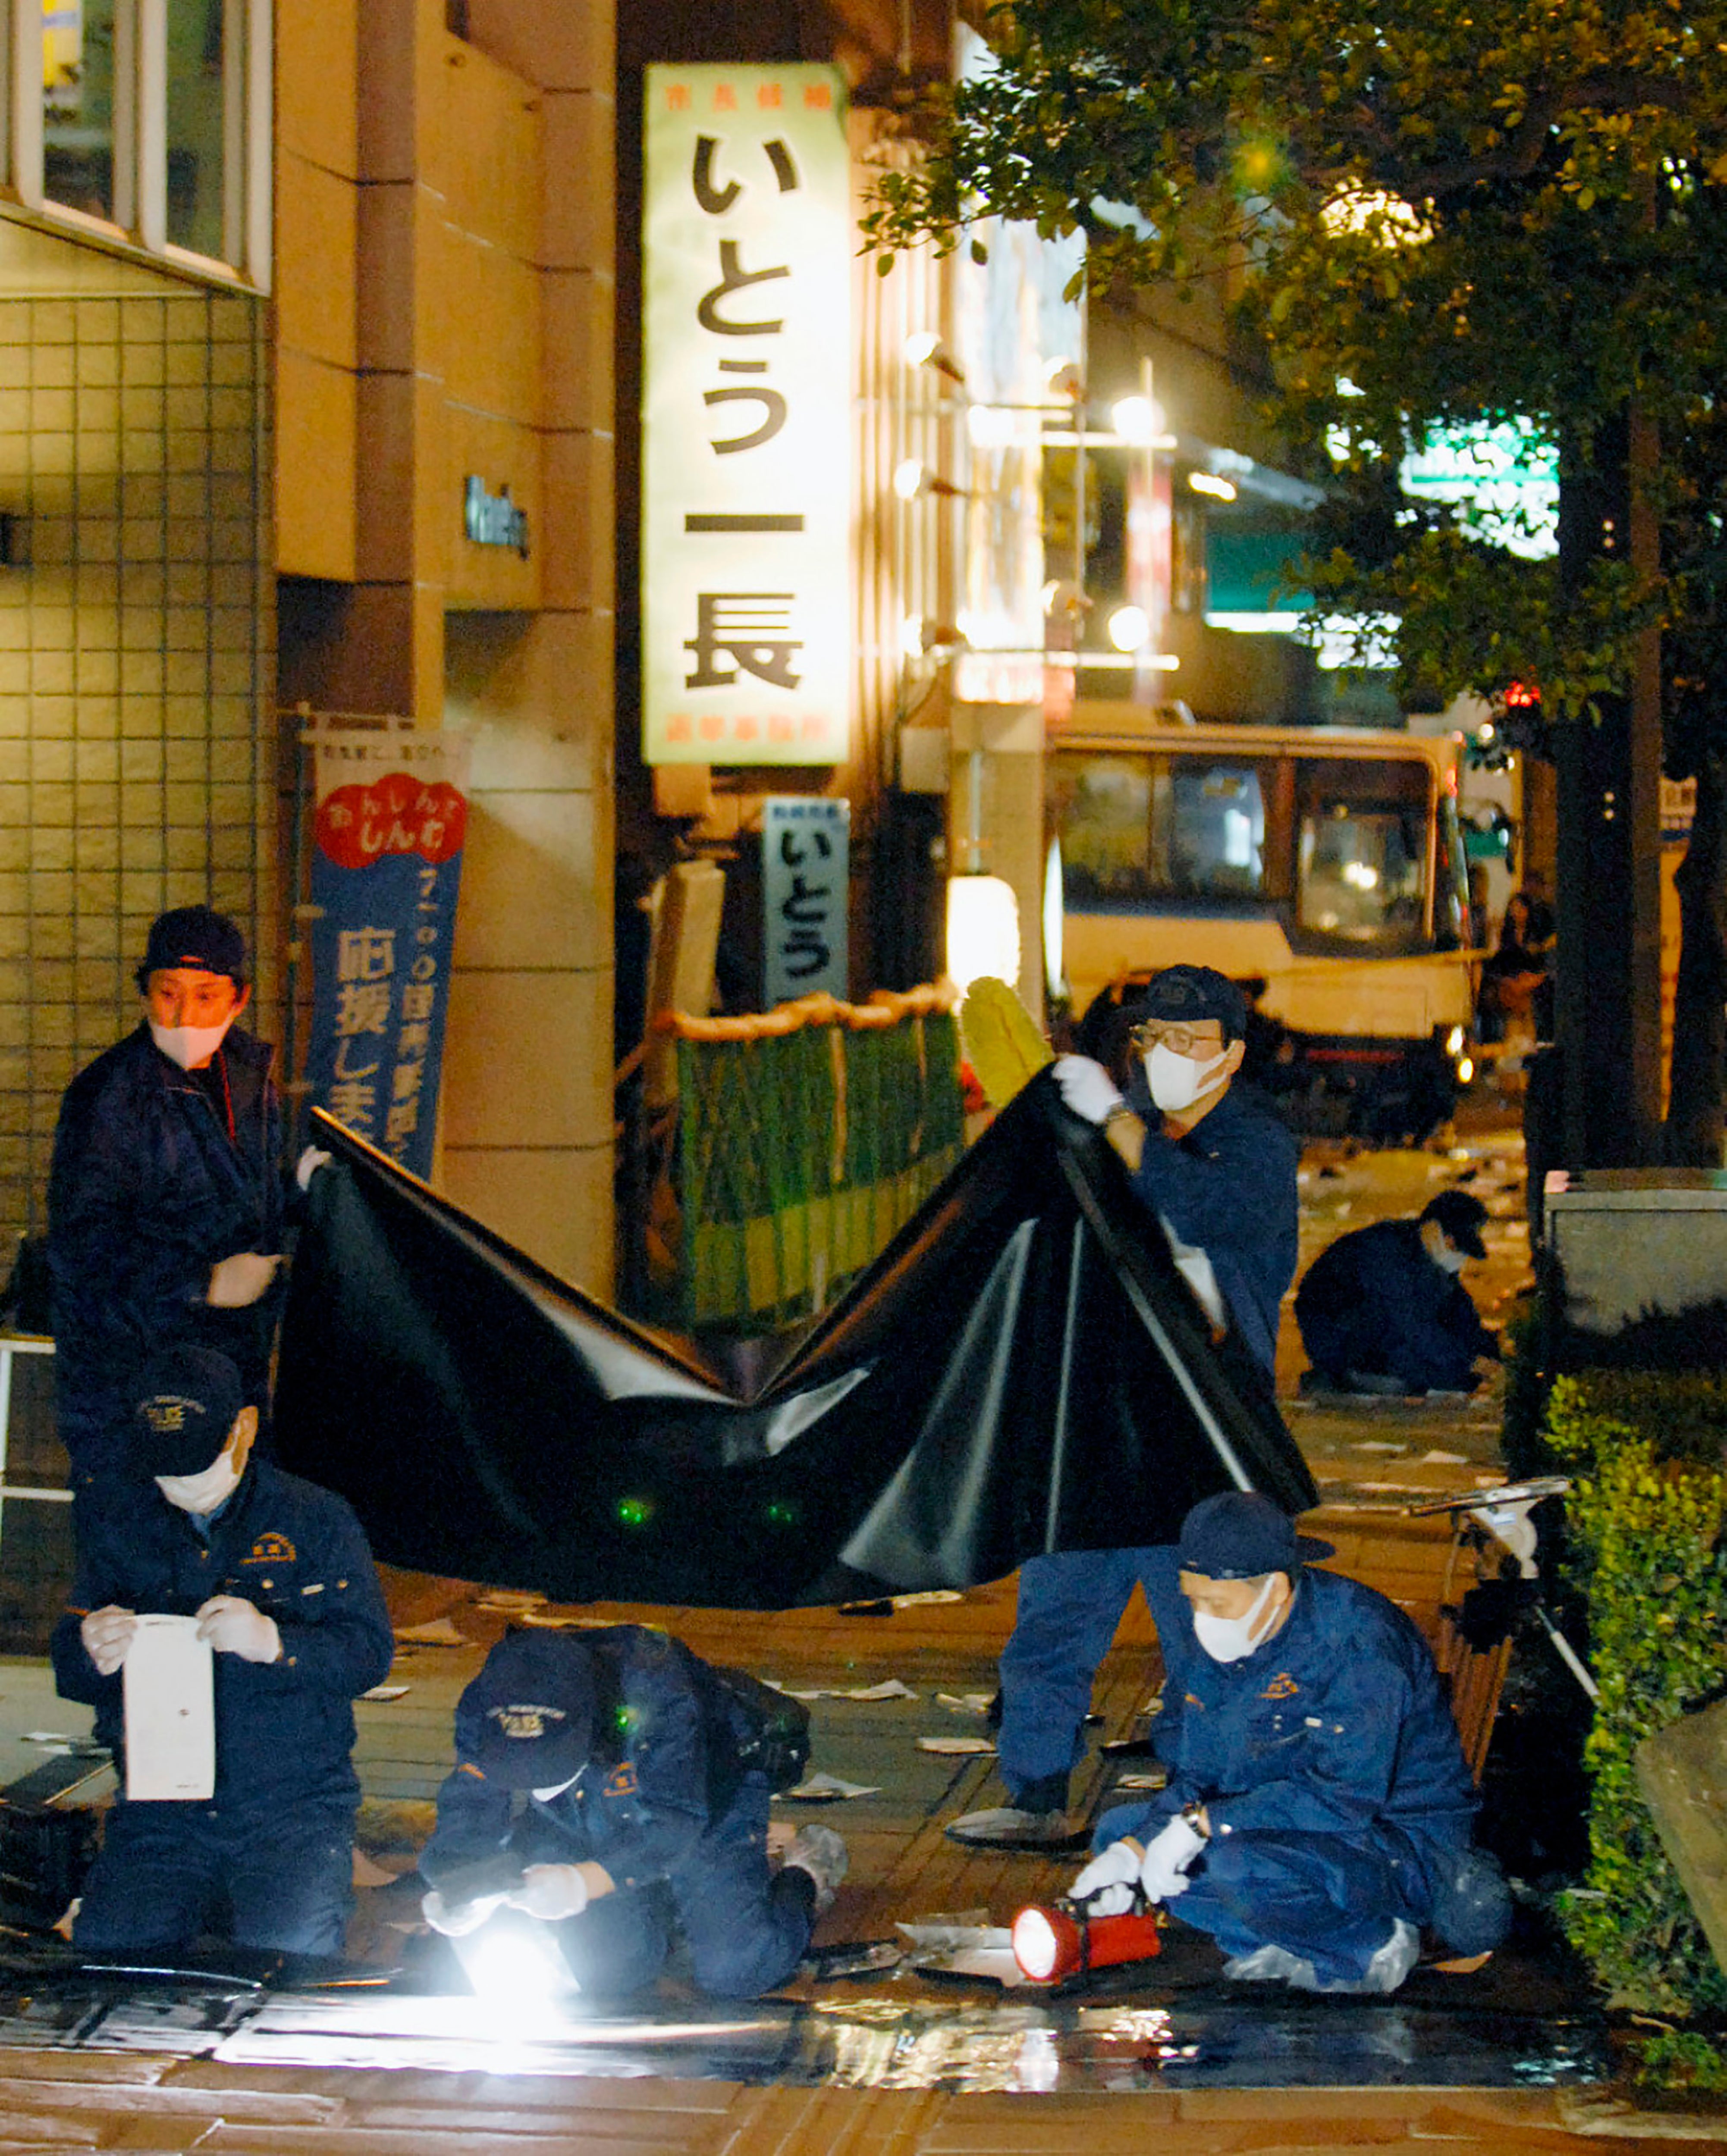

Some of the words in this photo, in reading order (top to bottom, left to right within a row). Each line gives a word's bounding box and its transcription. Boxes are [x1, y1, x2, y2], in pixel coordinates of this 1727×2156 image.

[684, 133, 804, 689] いとう一長
[330, 926, 396, 1145] 応援しま
